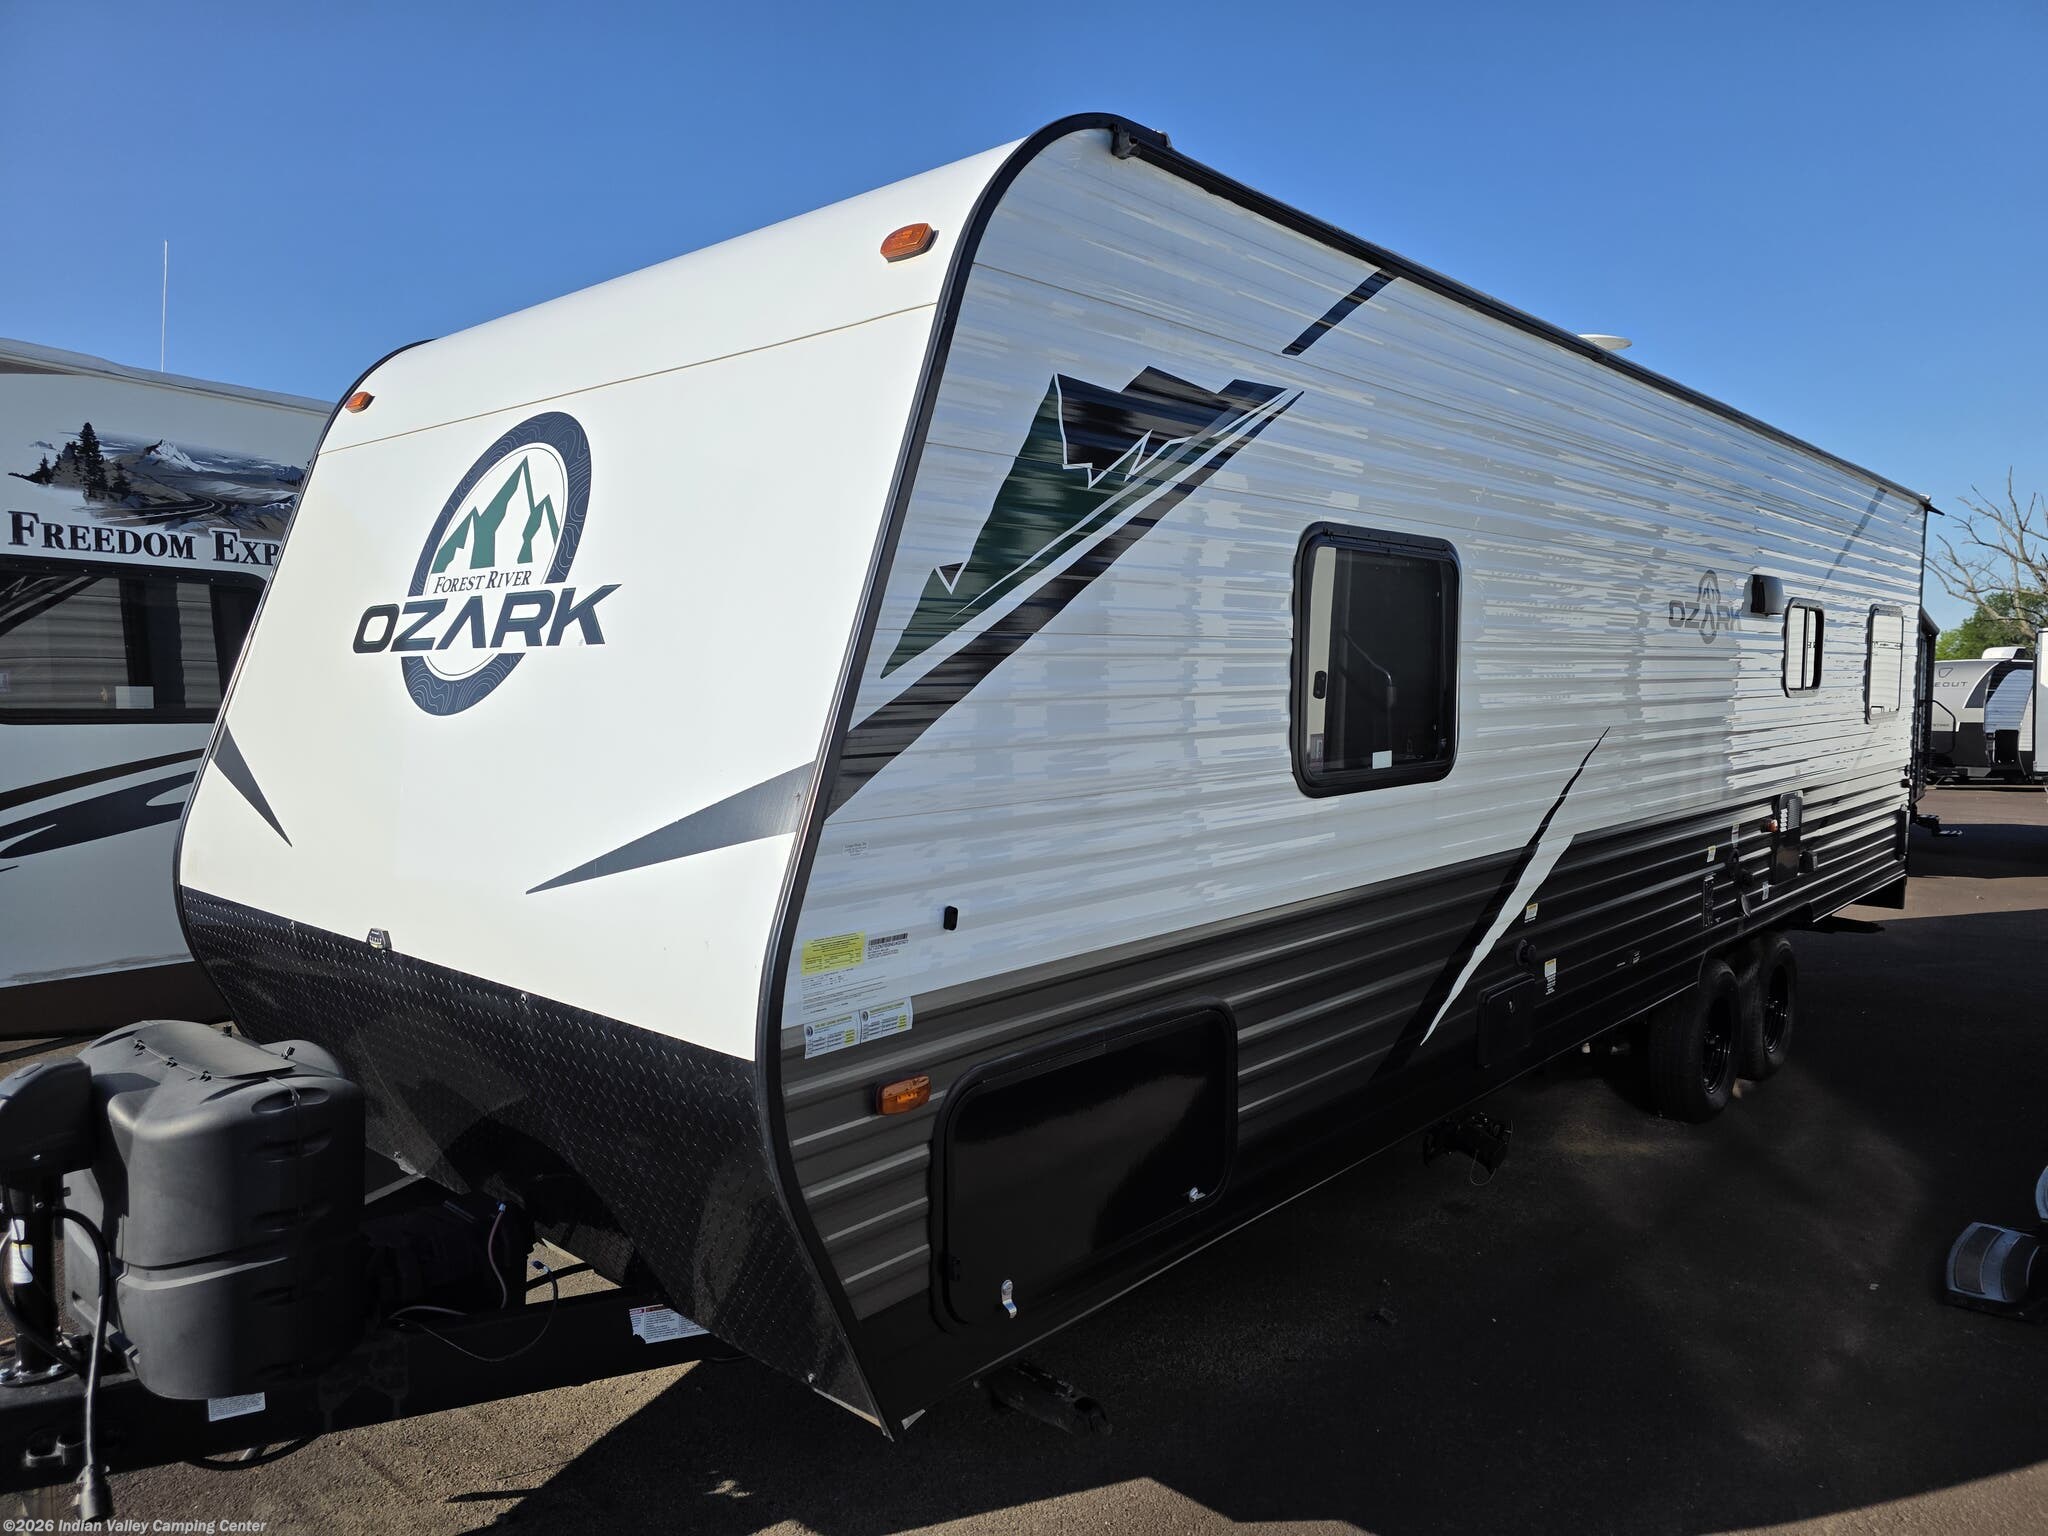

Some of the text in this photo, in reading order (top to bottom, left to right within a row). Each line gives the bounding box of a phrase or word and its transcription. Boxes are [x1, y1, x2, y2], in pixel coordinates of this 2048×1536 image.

[8, 511, 279, 566] FREEDOM EXP
[433, 570, 532, 594] FOREST RIVER
[353, 583, 622, 653] OZARK
[1669, 599, 1742, 631] OZARK
